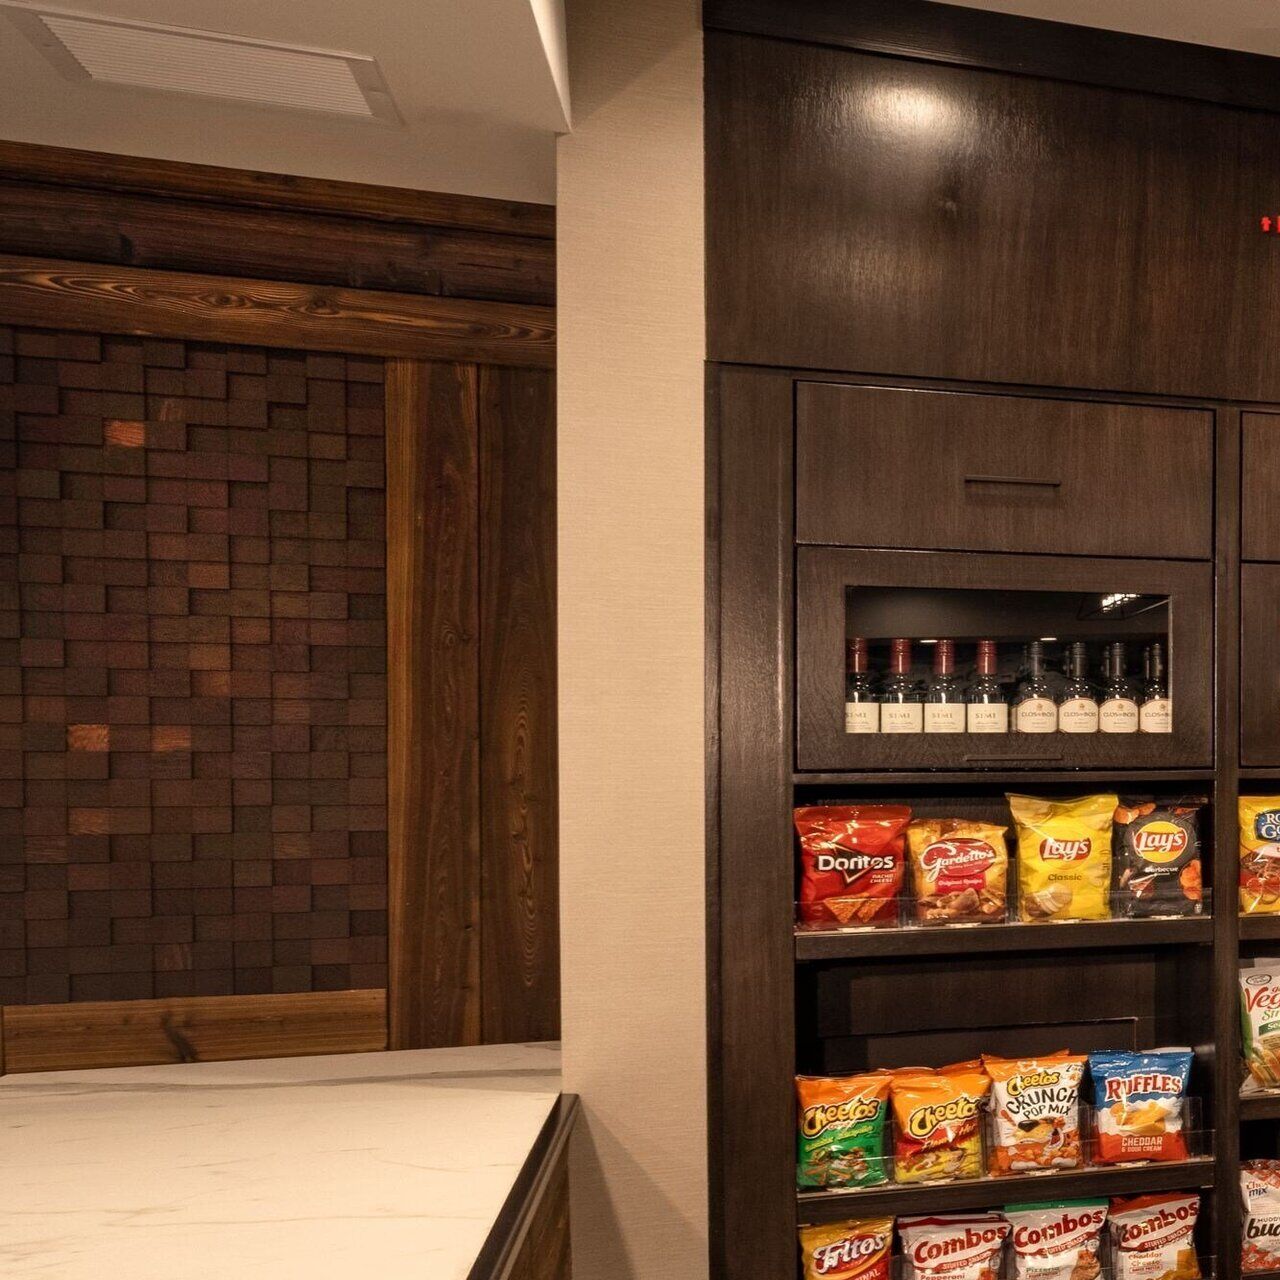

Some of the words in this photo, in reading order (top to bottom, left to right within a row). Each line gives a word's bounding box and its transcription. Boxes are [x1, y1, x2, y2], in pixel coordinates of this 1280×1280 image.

[1041, 836, 1091, 862] Lay's
[1137, 832, 1184, 853] Lay's
[817, 855, 894, 872] Doritos
[920, 839, 995, 883] Gardetto's
[1048, 873, 1082, 882] Classic
[1267, 1022, 1280, 1030] Sea
[1006, 1070, 1061, 1096] Cheetos
[1106, 1074, 1183, 1101] RUFFLES
[1006, 1086, 1079, 1115] CRUNCH
[1022, 1106, 1049, 1119] POP
[1048, 1104, 1071, 1117] MIX
[802, 1099, 879, 1138] Cheetos
[1121, 1135, 1163, 1148] CHEDDAR
[1012, 1207, 1105, 1248] Combos
[1120, 1201, 1199, 1240] Combos
[813, 1233, 886, 1273] Fritos
[913, 1223, 1011, 1264] Combos
